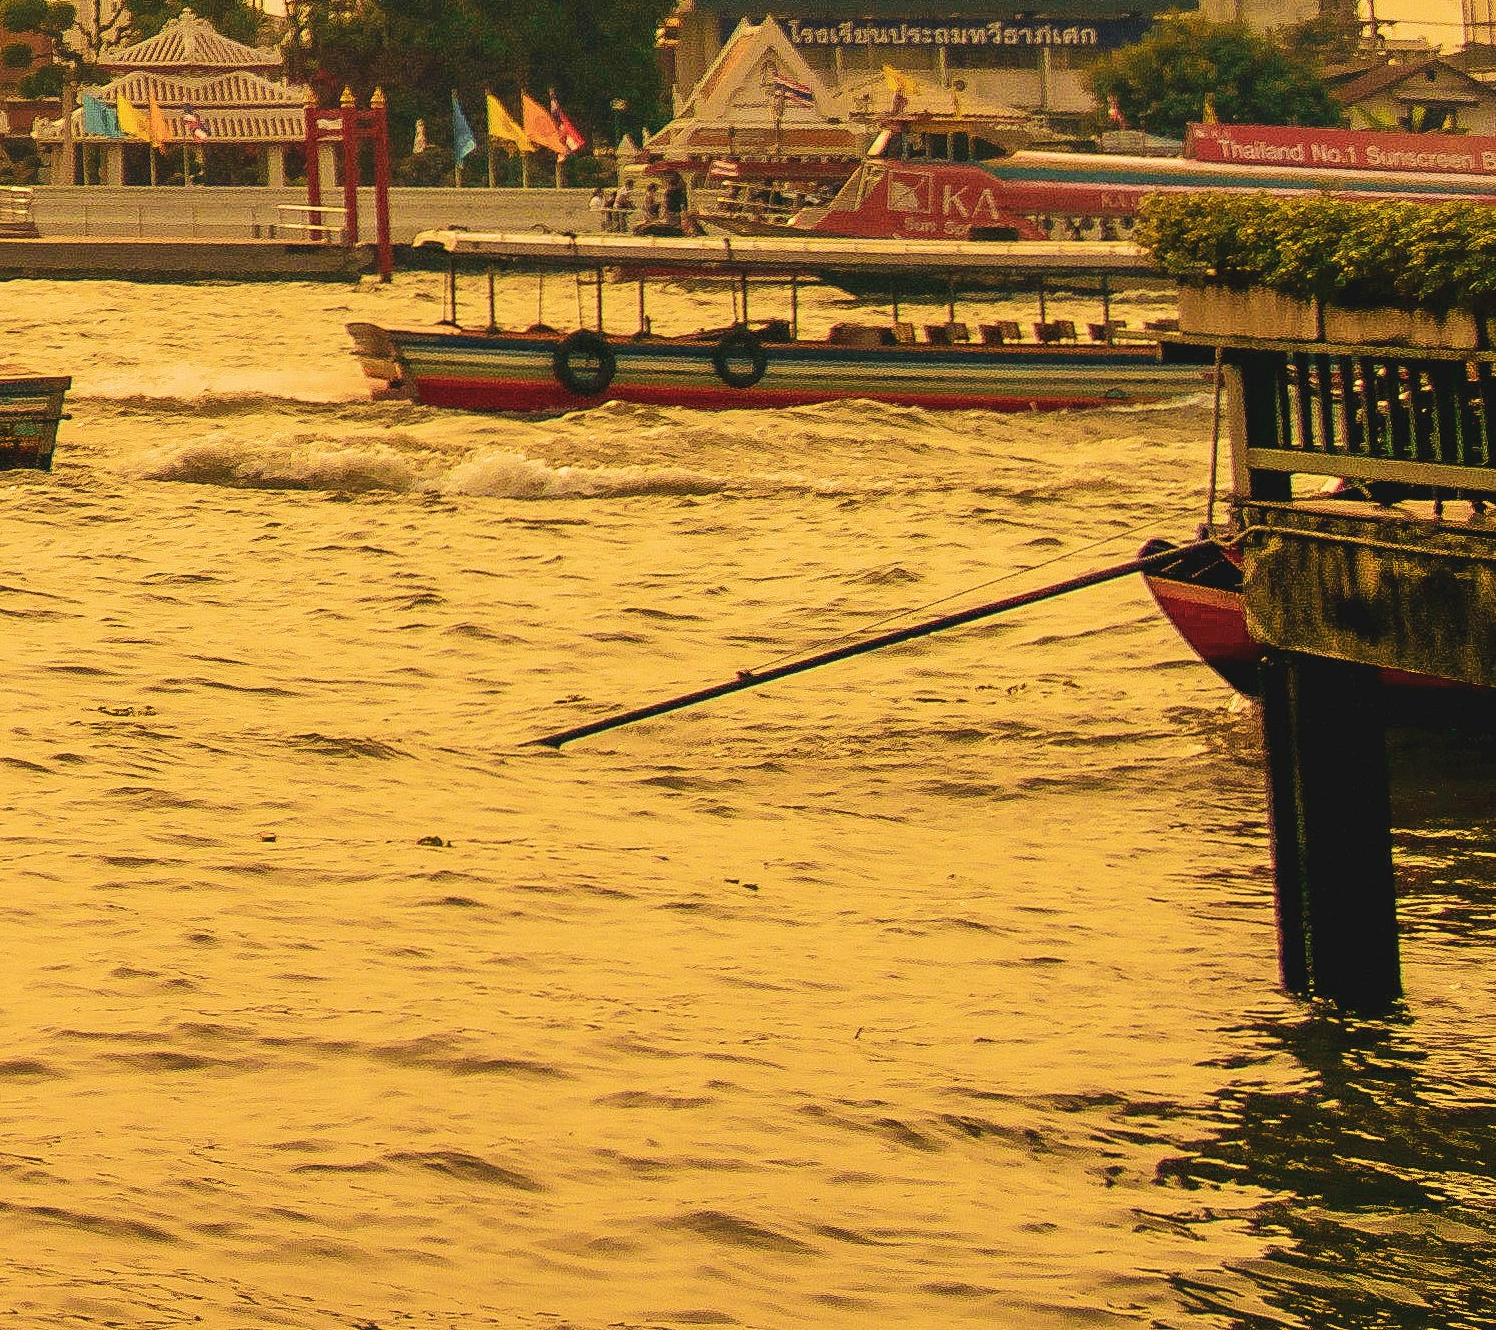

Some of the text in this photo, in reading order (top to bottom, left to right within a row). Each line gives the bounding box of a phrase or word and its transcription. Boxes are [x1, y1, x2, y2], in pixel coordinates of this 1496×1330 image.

[1217, 139, 1305, 162] Thailand
[1310, 142, 1356, 164] No.1
[1365, 145, 1473, 170] Sunscreen
[942, 184, 999, 220] KA
